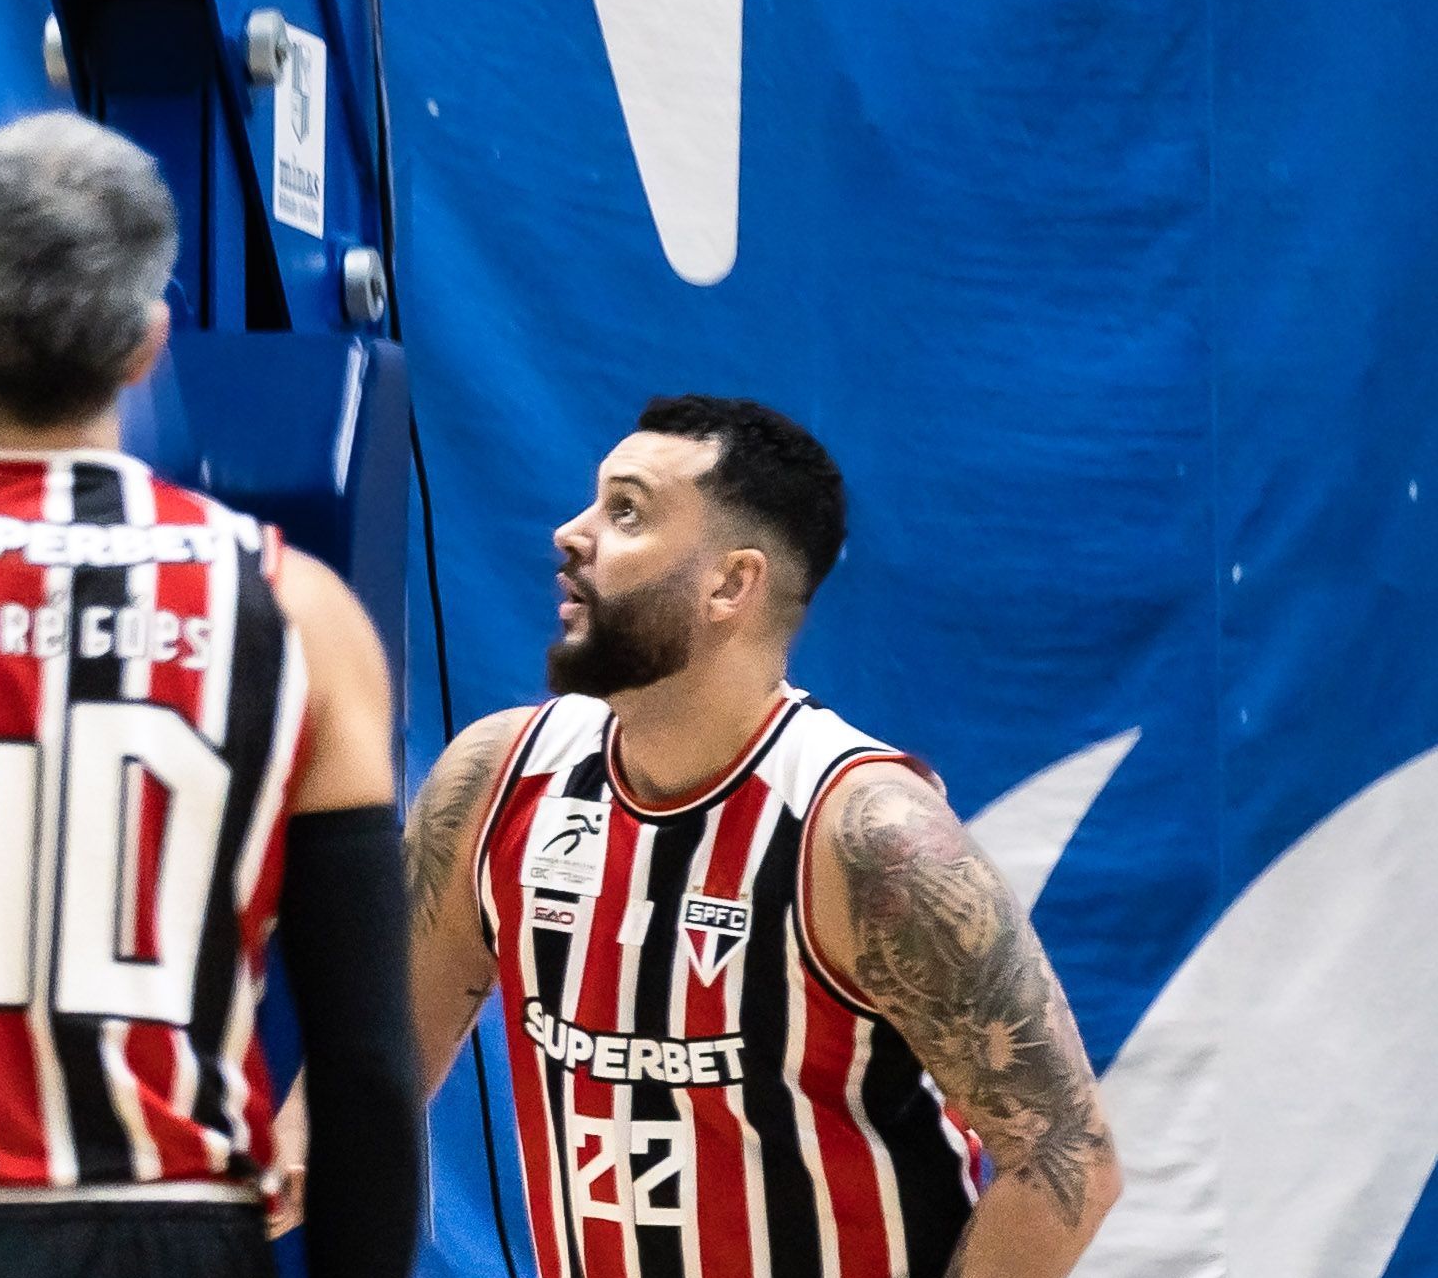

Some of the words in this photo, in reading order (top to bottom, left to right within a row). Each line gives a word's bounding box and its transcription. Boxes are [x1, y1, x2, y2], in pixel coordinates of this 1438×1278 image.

[688, 902, 747, 930] SPFC
[525, 1000, 745, 1084] SUPERBET
[570, 1113, 685, 1226] 22
